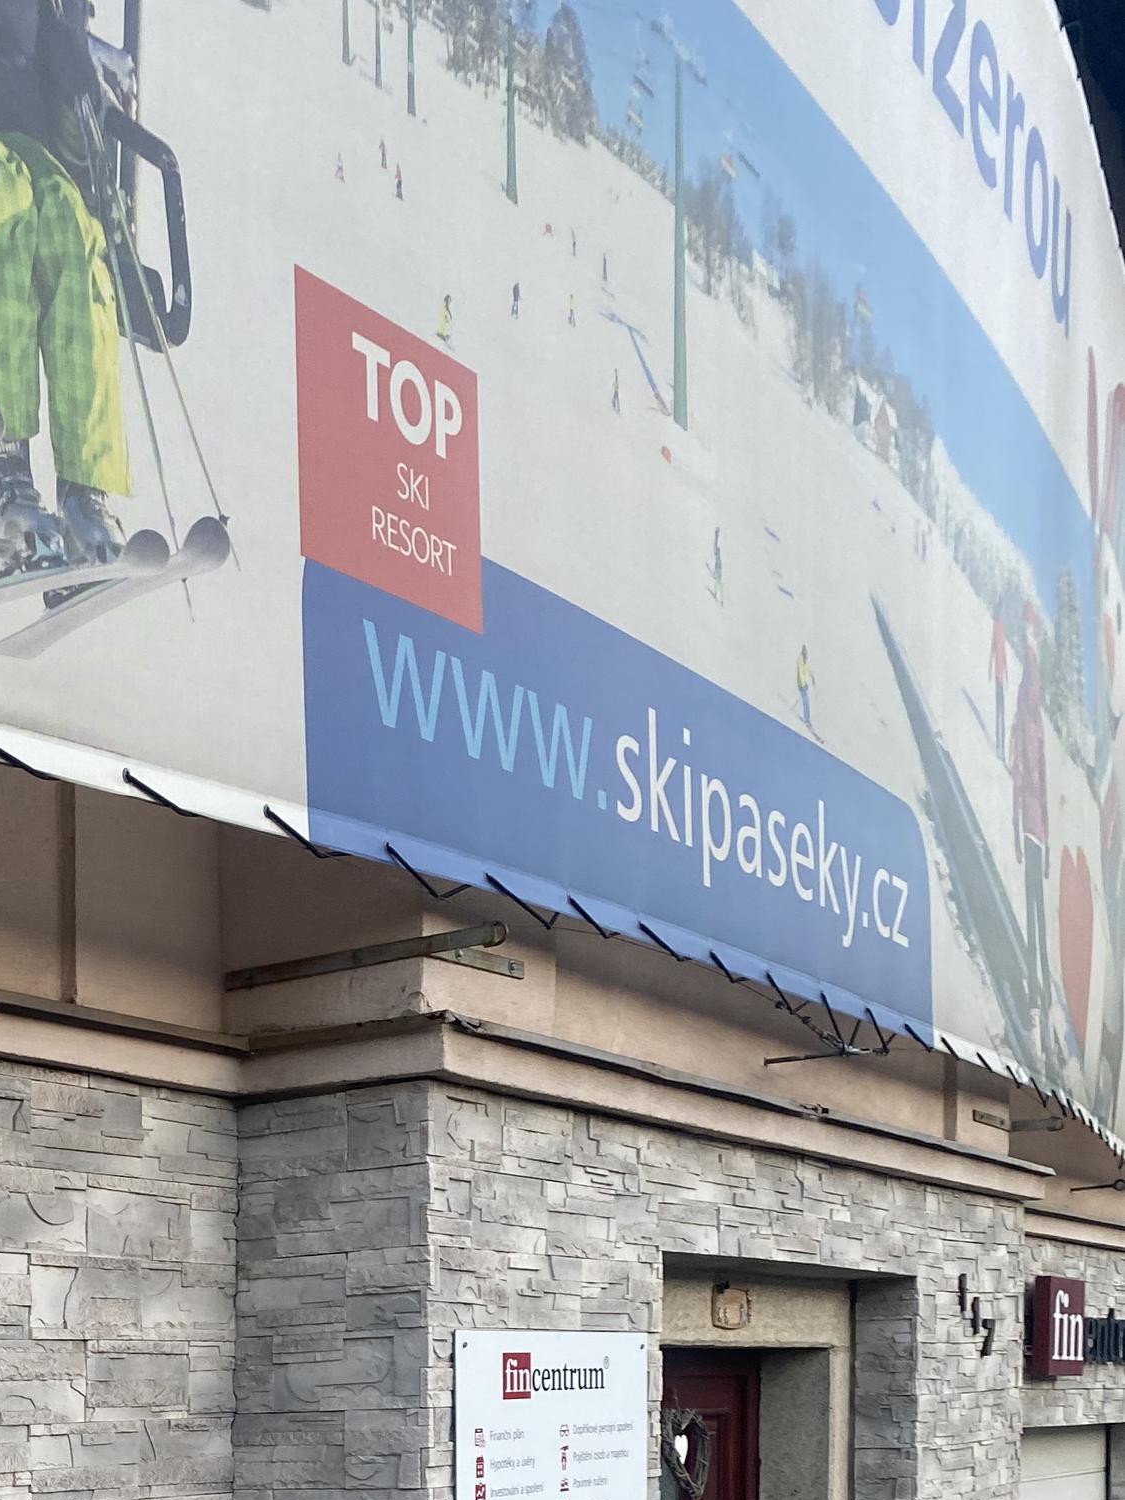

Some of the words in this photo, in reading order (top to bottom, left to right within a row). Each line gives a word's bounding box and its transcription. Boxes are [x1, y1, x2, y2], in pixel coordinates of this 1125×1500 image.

[876, 0, 1072, 340] zerou
[352, 331, 463, 459] TOP
[371, 505, 457, 577] RESORT
[396, 462, 430, 512] SKI
[362, 618, 910, 949] www.skipaseky.cz
